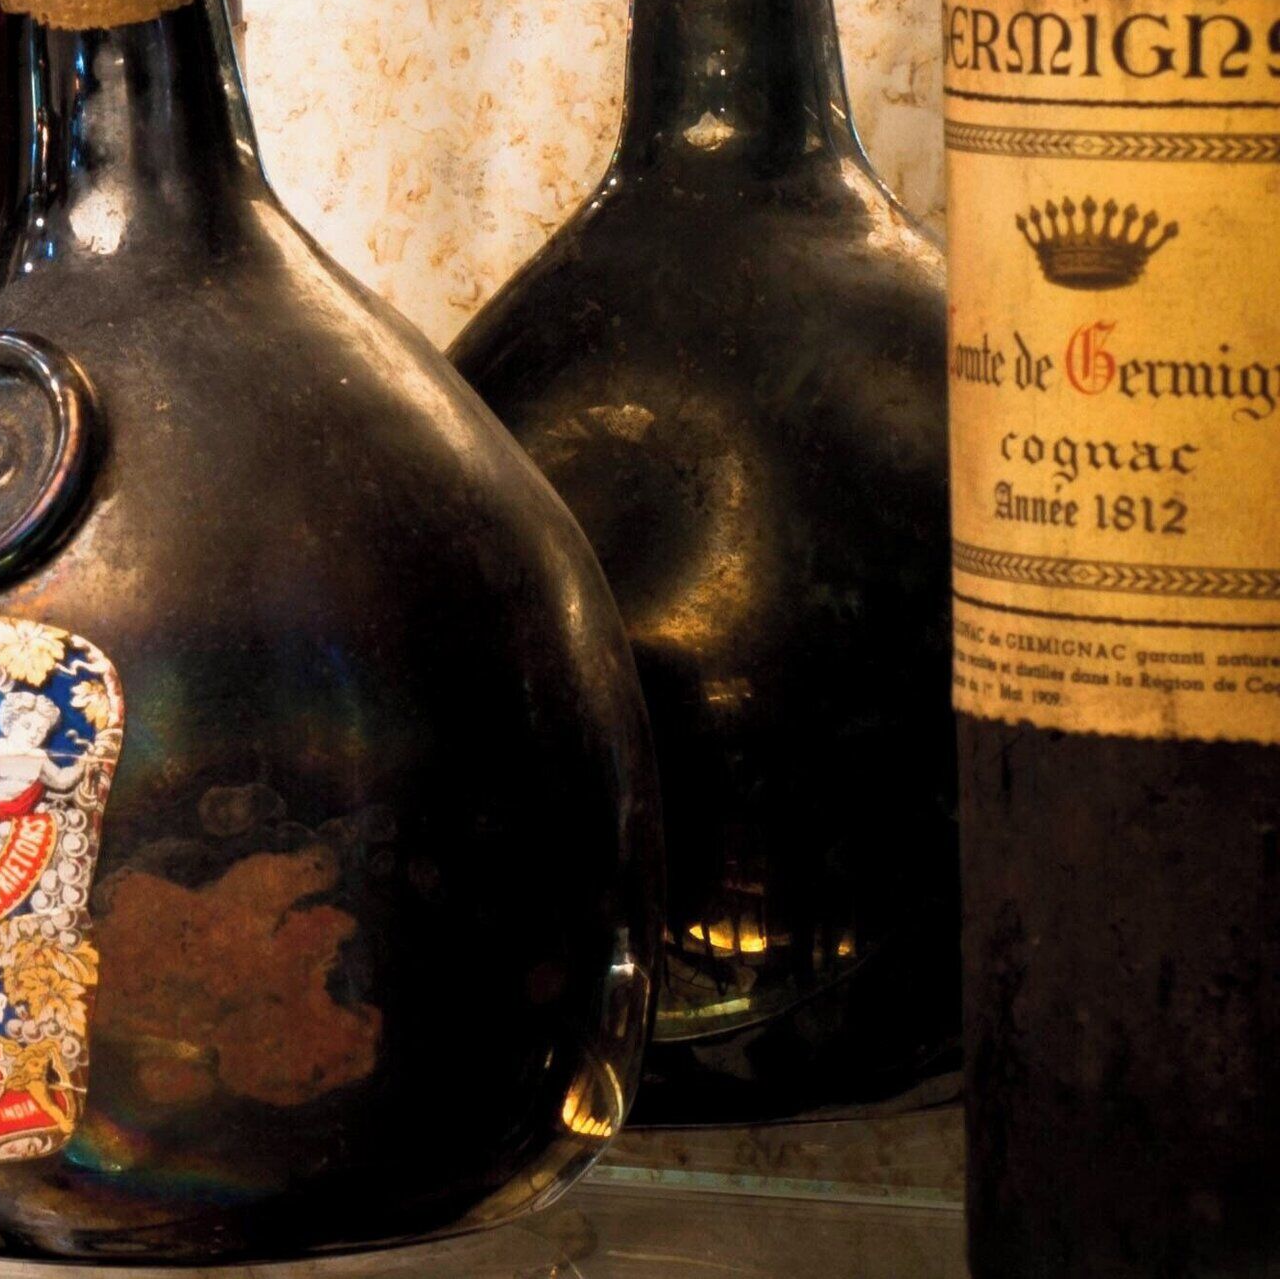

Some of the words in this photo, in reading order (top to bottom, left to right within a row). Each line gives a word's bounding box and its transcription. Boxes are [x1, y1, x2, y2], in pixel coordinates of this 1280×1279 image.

[950, 331, 1005, 388] omte
[1013, 331, 1053, 391] de
[1066, 321, 1280, 421] Germig
[1000, 430, 1200, 484] cognac
[993, 479, 1079, 528] Année
[1095, 494, 1189, 535] 1812
[1006, 631, 1126, 661] GERMIGNAC
[0, 1099, 39, 1119] INDIA
